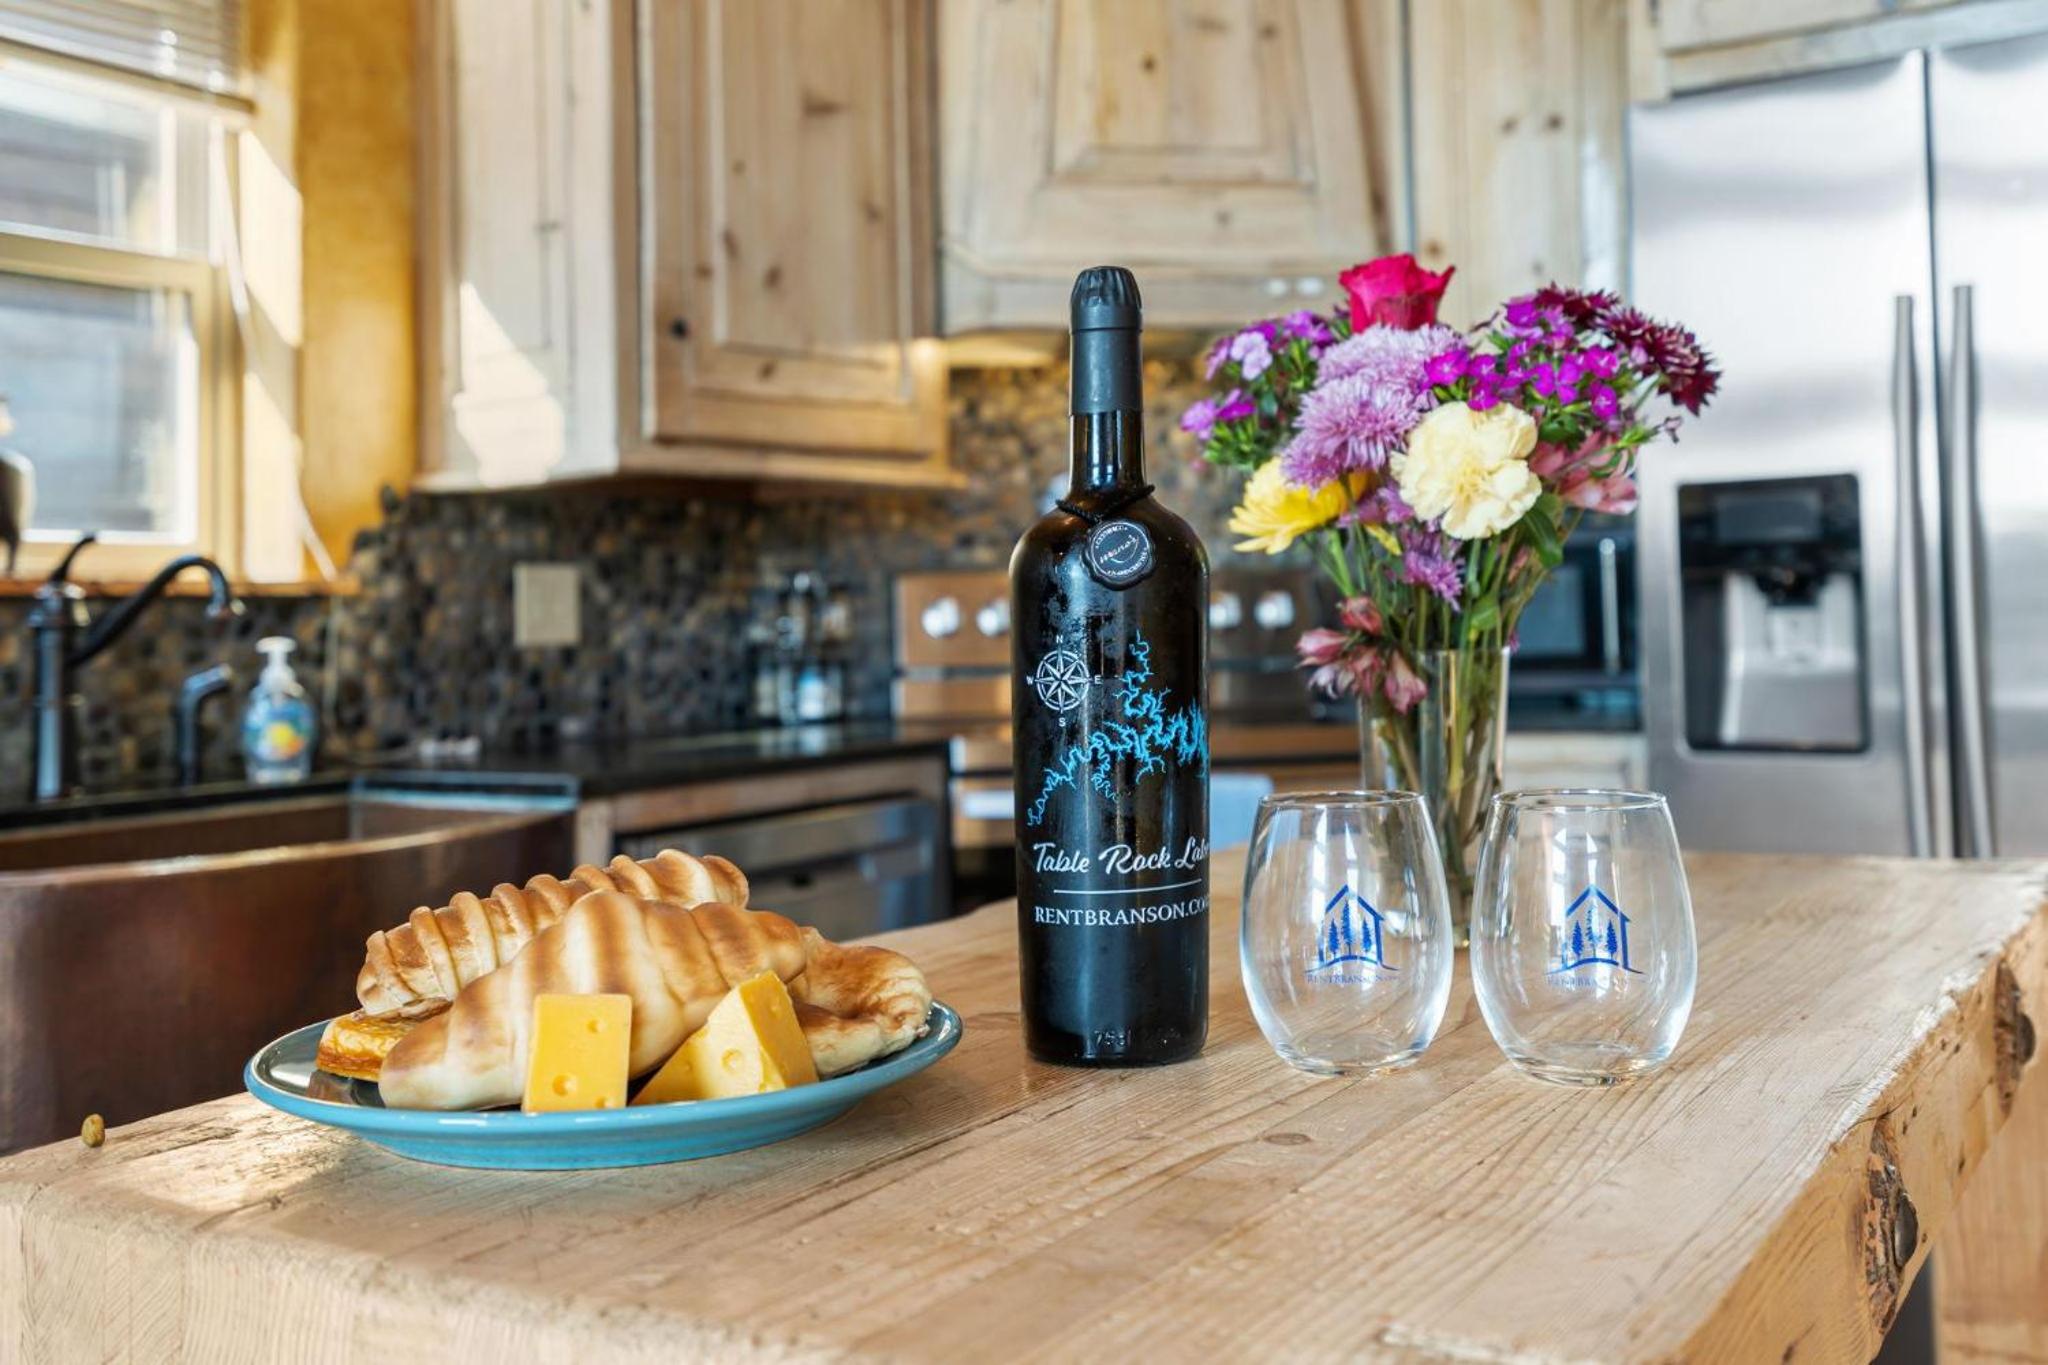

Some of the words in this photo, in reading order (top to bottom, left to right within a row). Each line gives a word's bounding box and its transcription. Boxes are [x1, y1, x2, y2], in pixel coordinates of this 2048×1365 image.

[1056, 634, 1063, 644] N
[1026, 675, 1034, 685] W
[1094, 674, 1103, 685] E
[1058, 717, 1066, 727] S
[1033, 842, 1090, 873] Table
[1098, 844, 1171, 874] Rock
